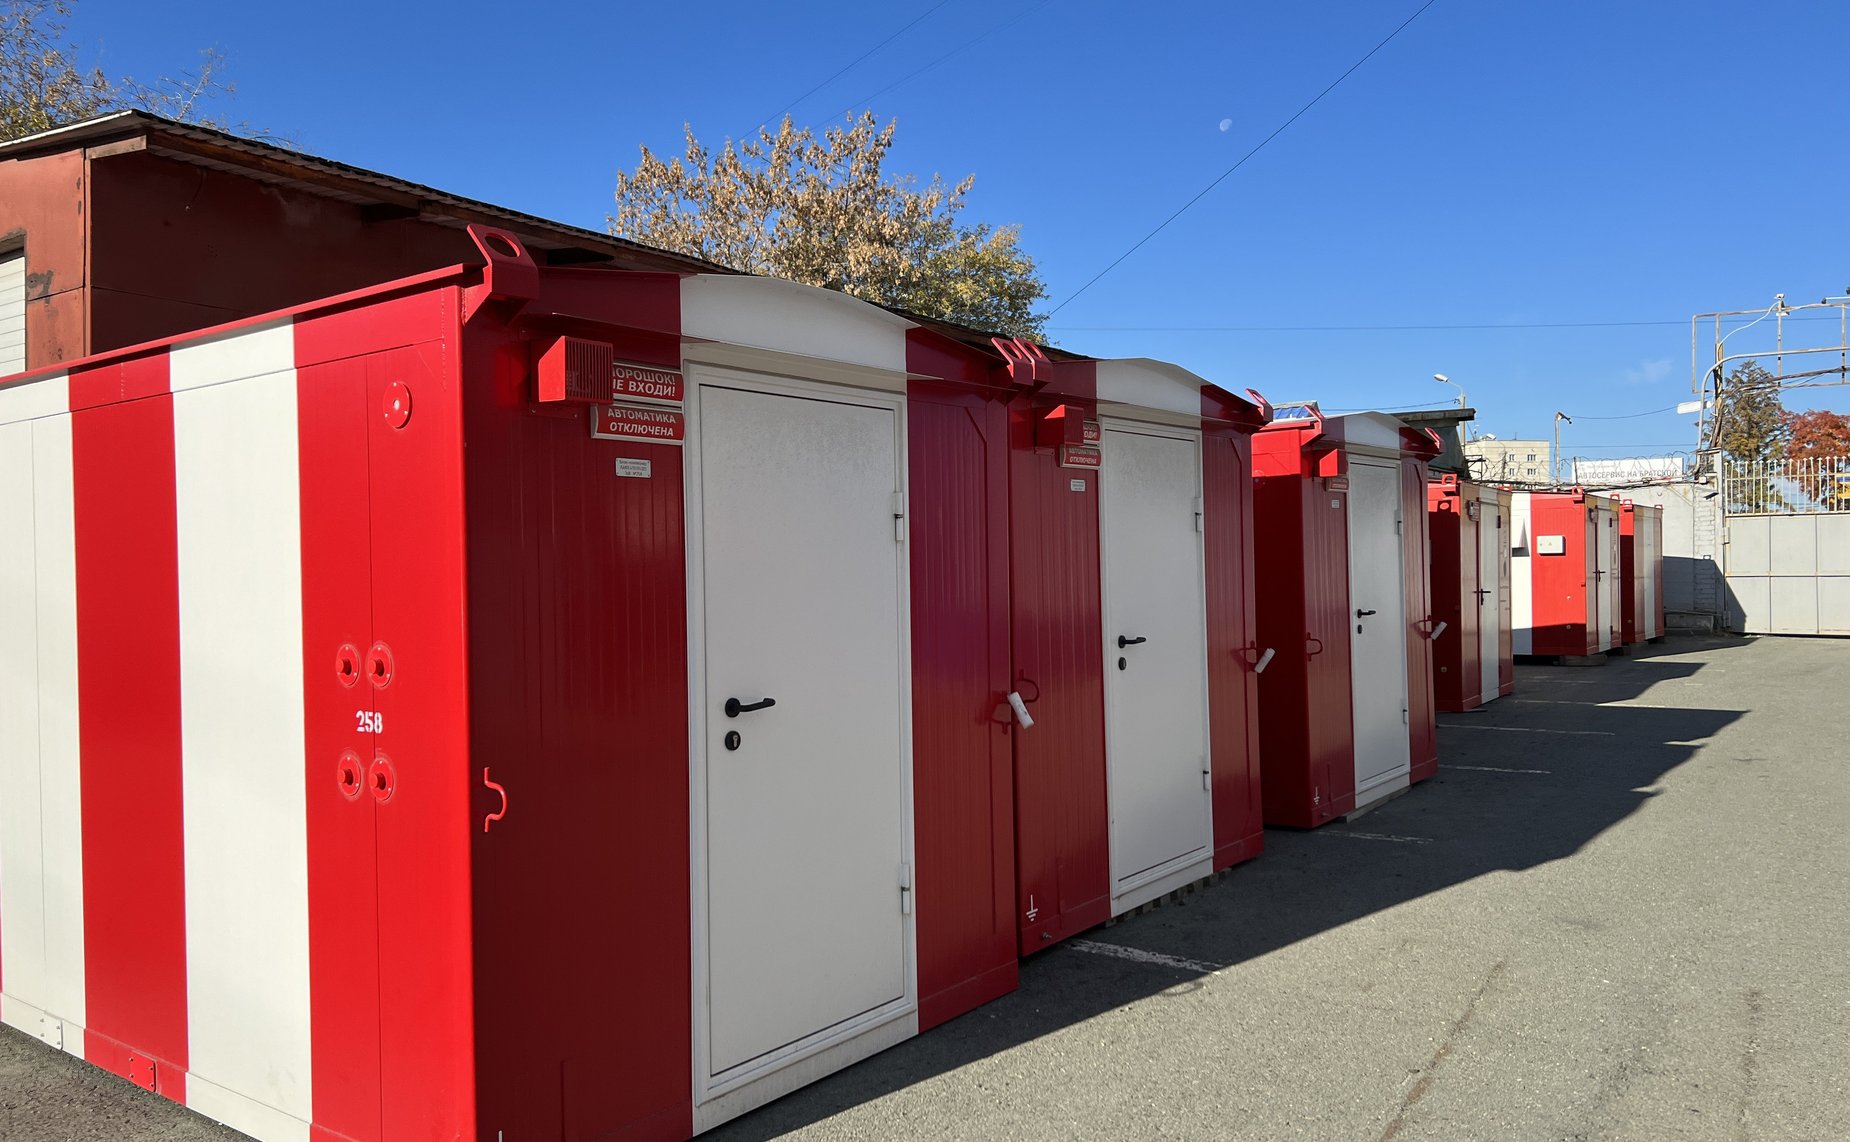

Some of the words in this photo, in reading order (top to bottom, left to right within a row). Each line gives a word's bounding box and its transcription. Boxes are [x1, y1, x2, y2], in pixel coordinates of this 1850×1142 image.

[628, 381, 675, 396] ВХОДИ!
[608, 408, 676, 424] АВТОМАТИКА
[609, 422, 674, 437] ОТКЛЮЧЕНА
[1578, 471, 1625, 479] АВТОСЕРВИС
[1639, 469, 1678, 477] БРАТСКОЙ
[355, 709, 383, 734] 258
